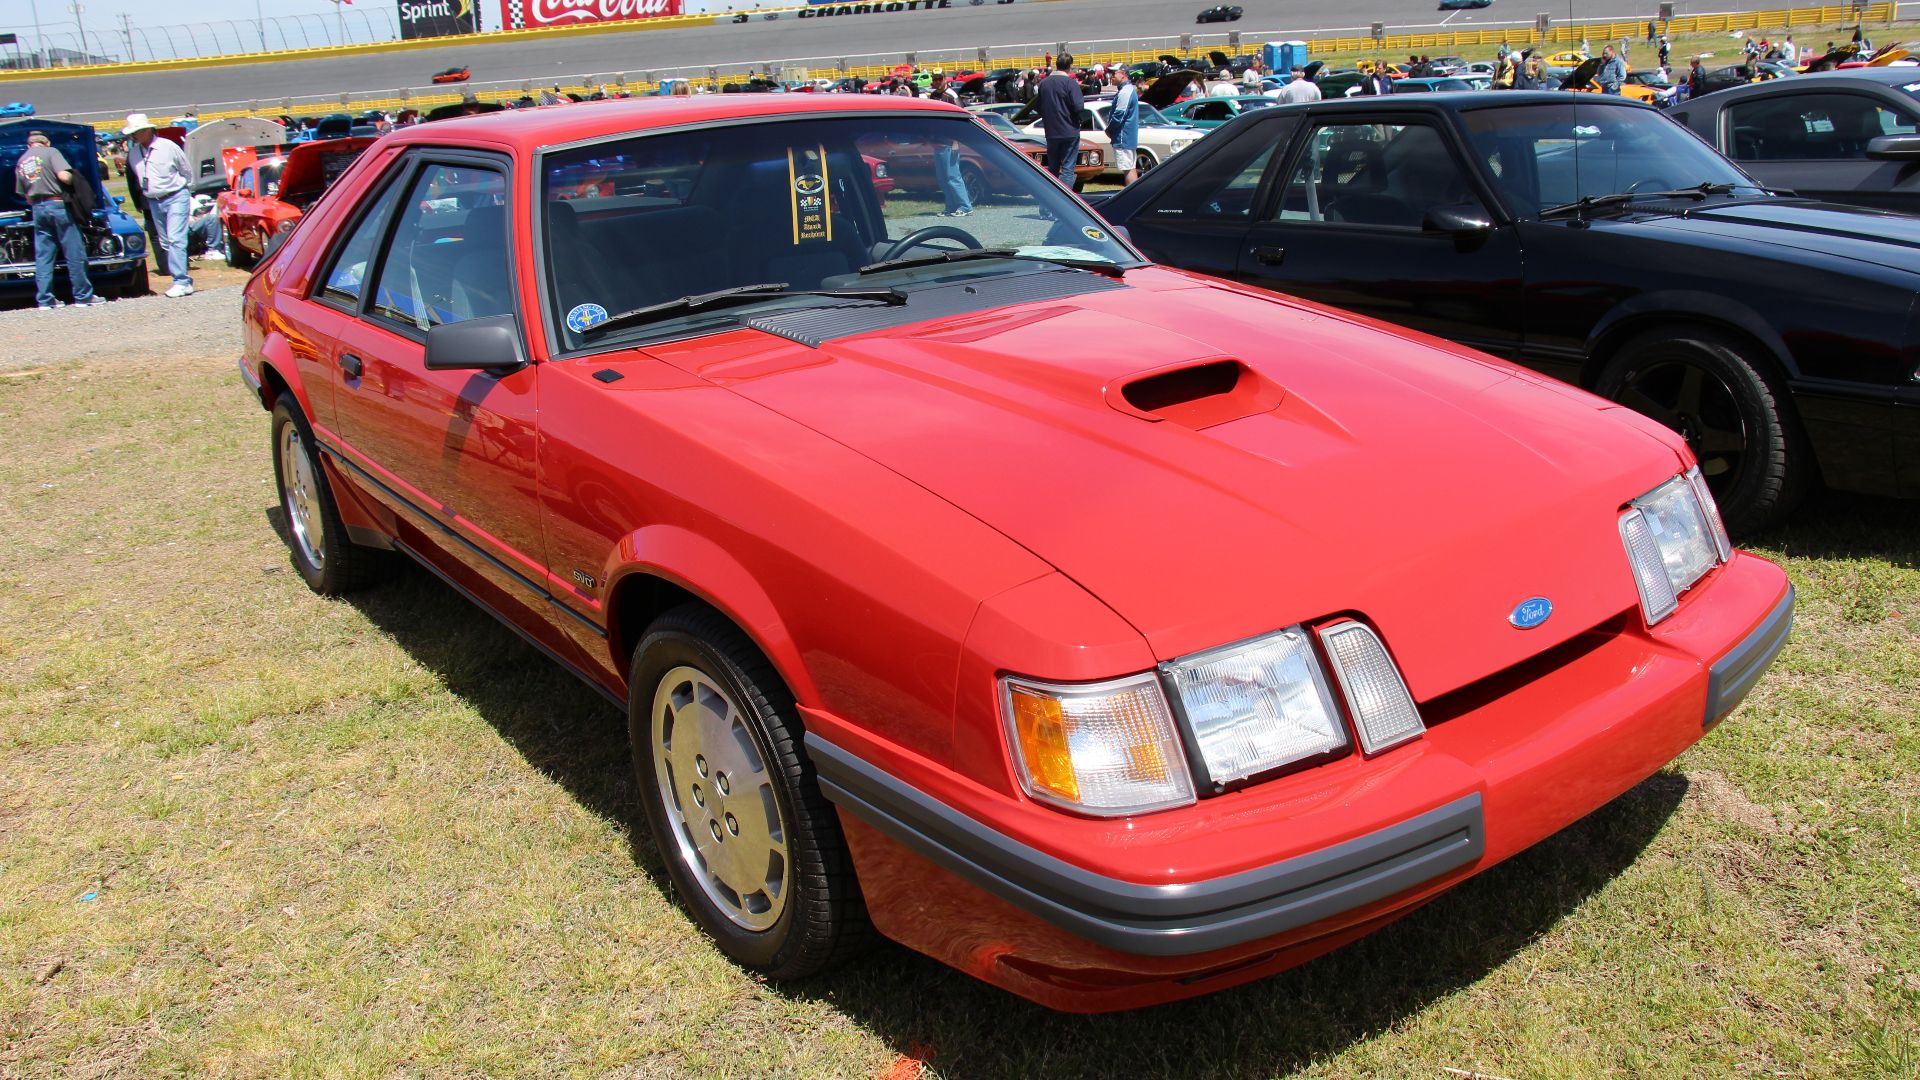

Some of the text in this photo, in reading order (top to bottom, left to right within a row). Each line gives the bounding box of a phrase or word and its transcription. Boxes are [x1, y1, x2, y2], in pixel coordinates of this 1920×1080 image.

[401, 0, 451, 23] Sprint
[532, 0, 669, 24] CocaCola
[798, 0, 952, 18] CHARLOTTE
[573, 570, 594, 588] SVO
[1521, 603, 1544, 623] Ford
